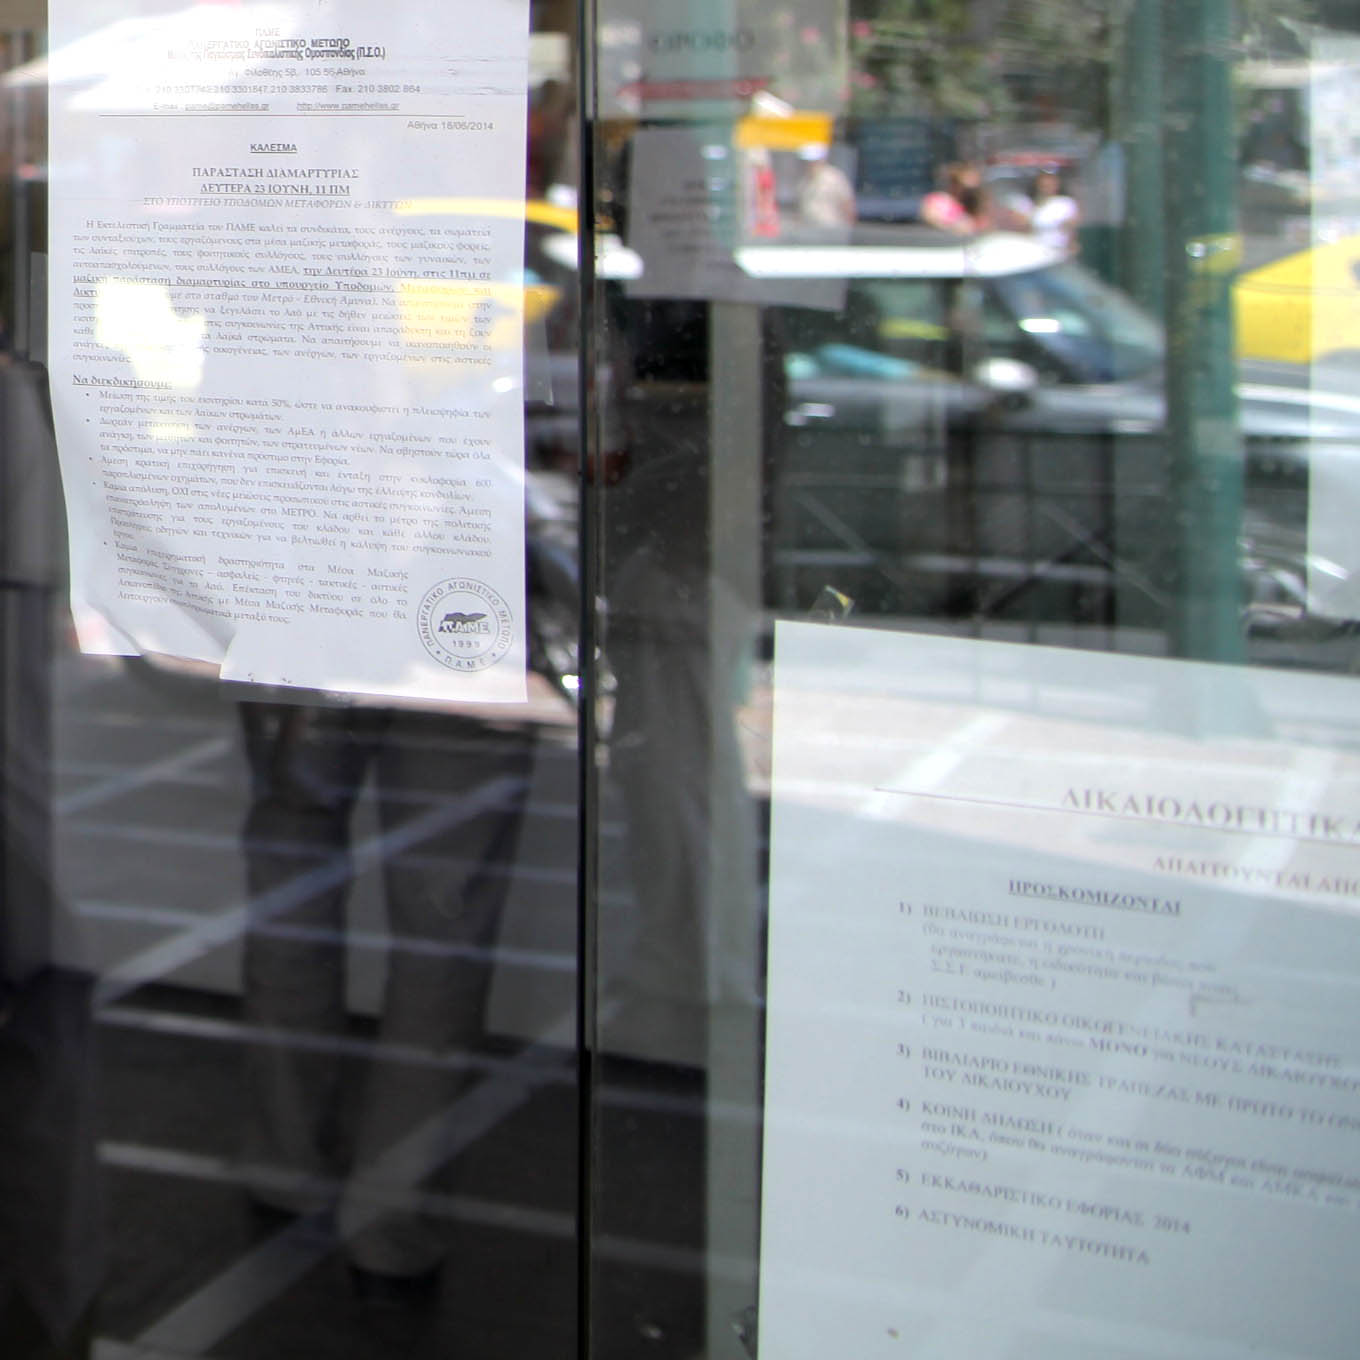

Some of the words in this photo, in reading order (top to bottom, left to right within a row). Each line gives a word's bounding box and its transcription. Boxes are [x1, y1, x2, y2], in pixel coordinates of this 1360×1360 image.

[250, 143, 298, 153] ΚΑΛΕΣΜΑ
[192, 167, 264, 178] ΠΑΡΑΣΤΑΣΗ
[265, 167, 360, 179] ΔΙΑΜΑΡΤΥΡΙΑΣ
[200, 183, 252, 194] ΔΕΥΤΕΡΑ
[254, 184, 266, 194] 23
[329, 185, 351, 195] ΠΜ
